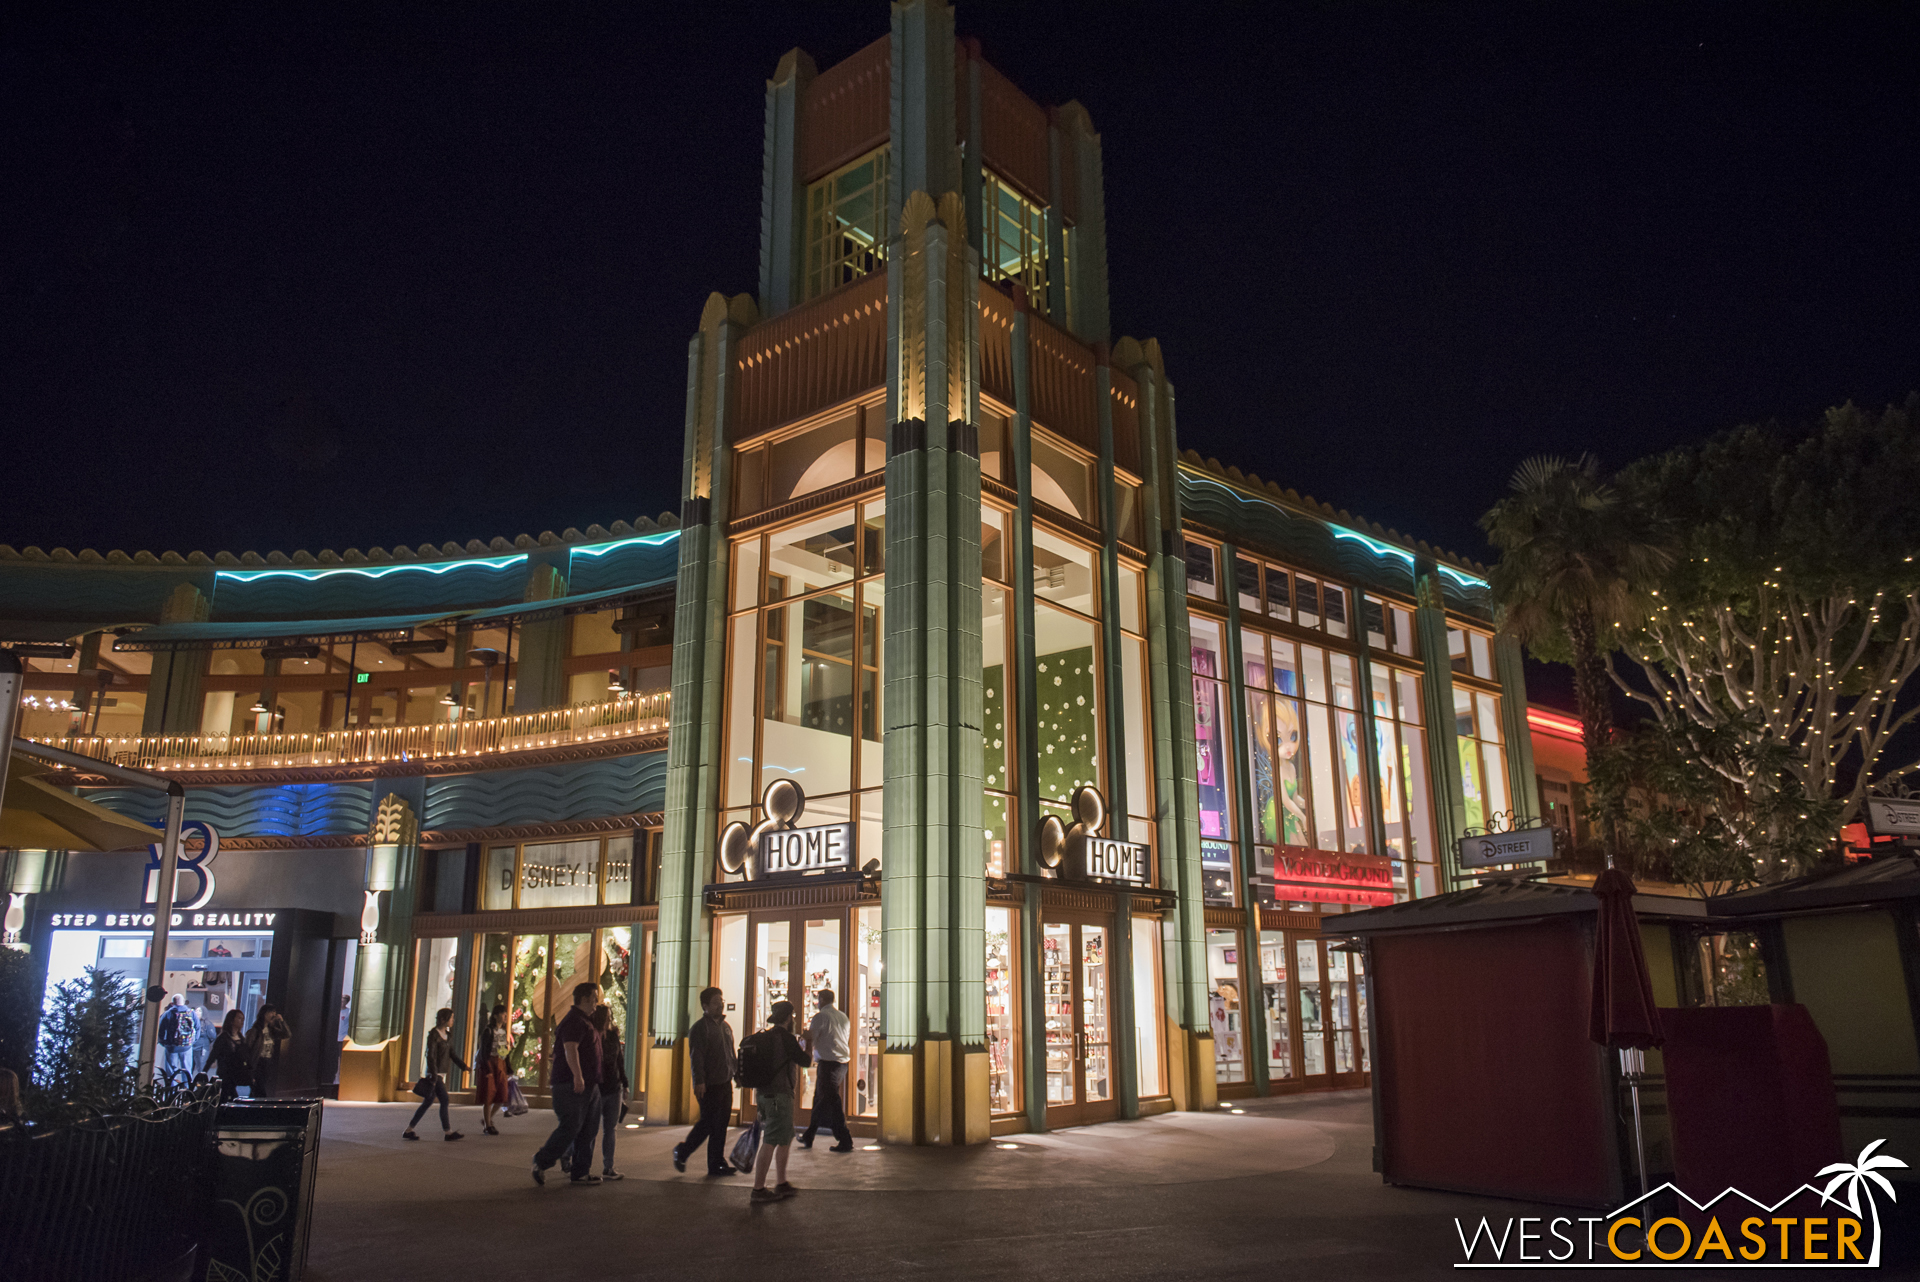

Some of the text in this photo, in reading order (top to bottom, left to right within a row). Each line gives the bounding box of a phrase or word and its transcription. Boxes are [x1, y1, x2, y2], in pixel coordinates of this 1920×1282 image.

[767, 829, 842, 868] HOME
[1091, 841, 1144, 876] HOME
[587, 860, 633, 885] HOM
[1303, 891, 1372, 902] GALLERY
[51, 913, 276, 926] STEP BEYOD REALITY
